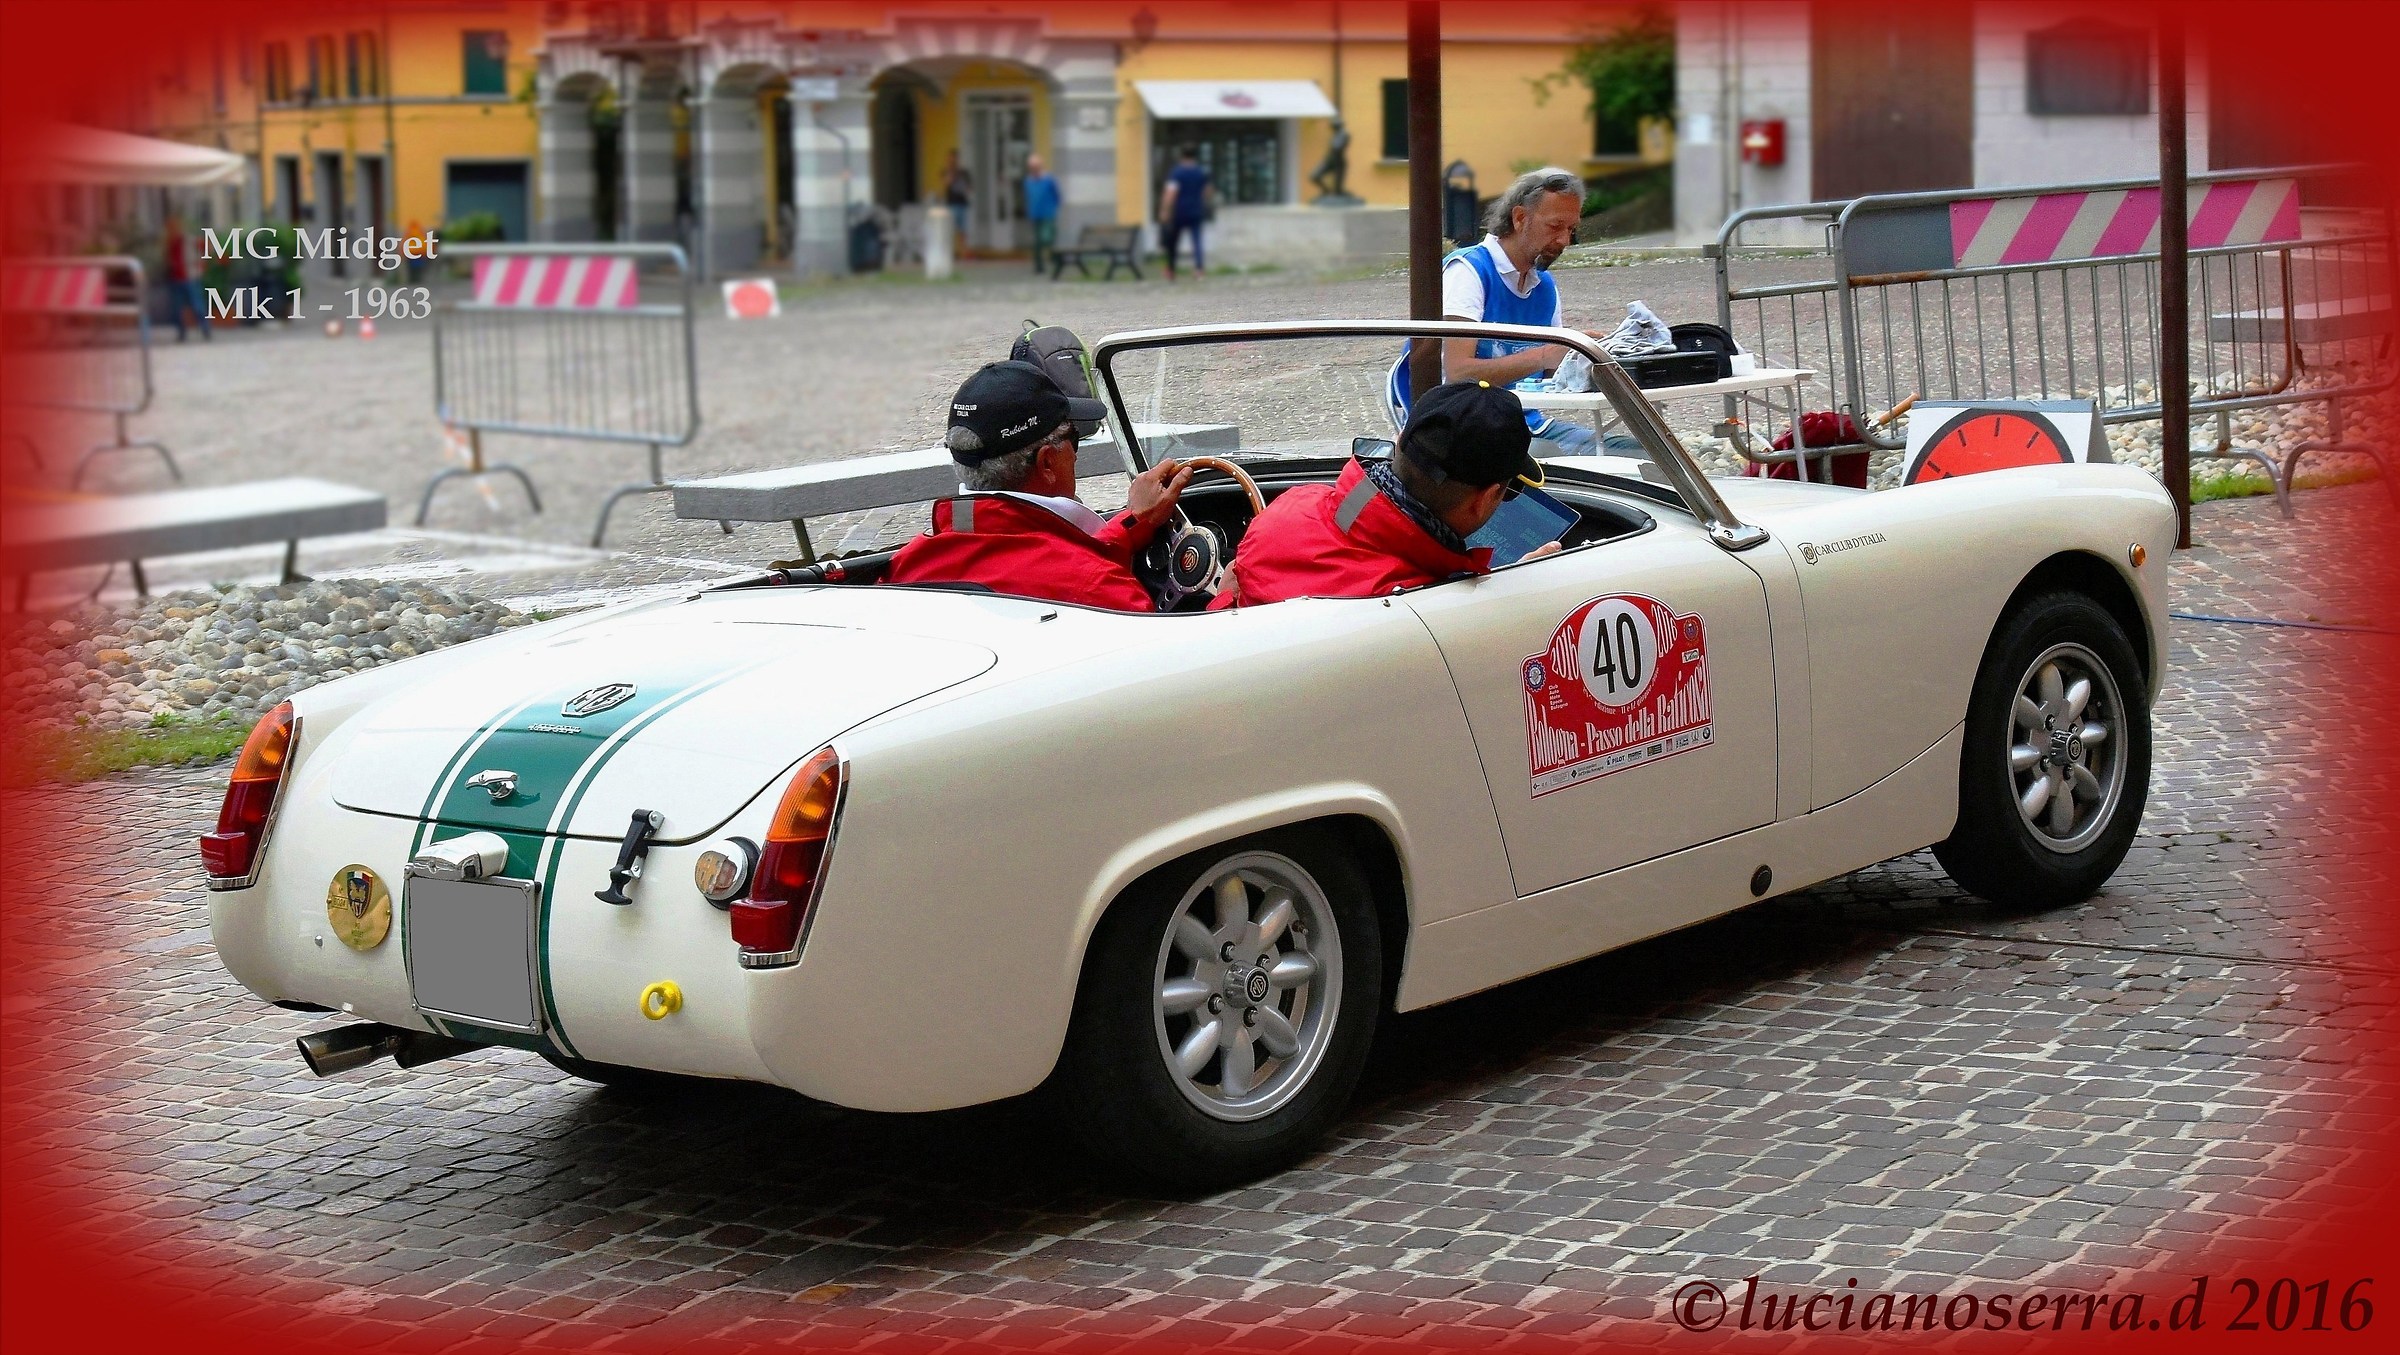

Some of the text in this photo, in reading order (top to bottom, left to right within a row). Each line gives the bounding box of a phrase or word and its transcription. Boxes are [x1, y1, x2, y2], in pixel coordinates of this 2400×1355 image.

[1814, 542, 1833, 557] CAR
[1831, 539, 1854, 553] CLUB
[1550, 624, 1580, 681] 2016
[1593, 612, 1642, 694] 40
[1651, 602, 1678, 658] 2016
[1526, 690, 1580, 771] Bologna
[1585, 721, 1623, 755] Passo
[1624, 706, 1656, 744] della
[1611, 755, 1626, 764] PILOT
